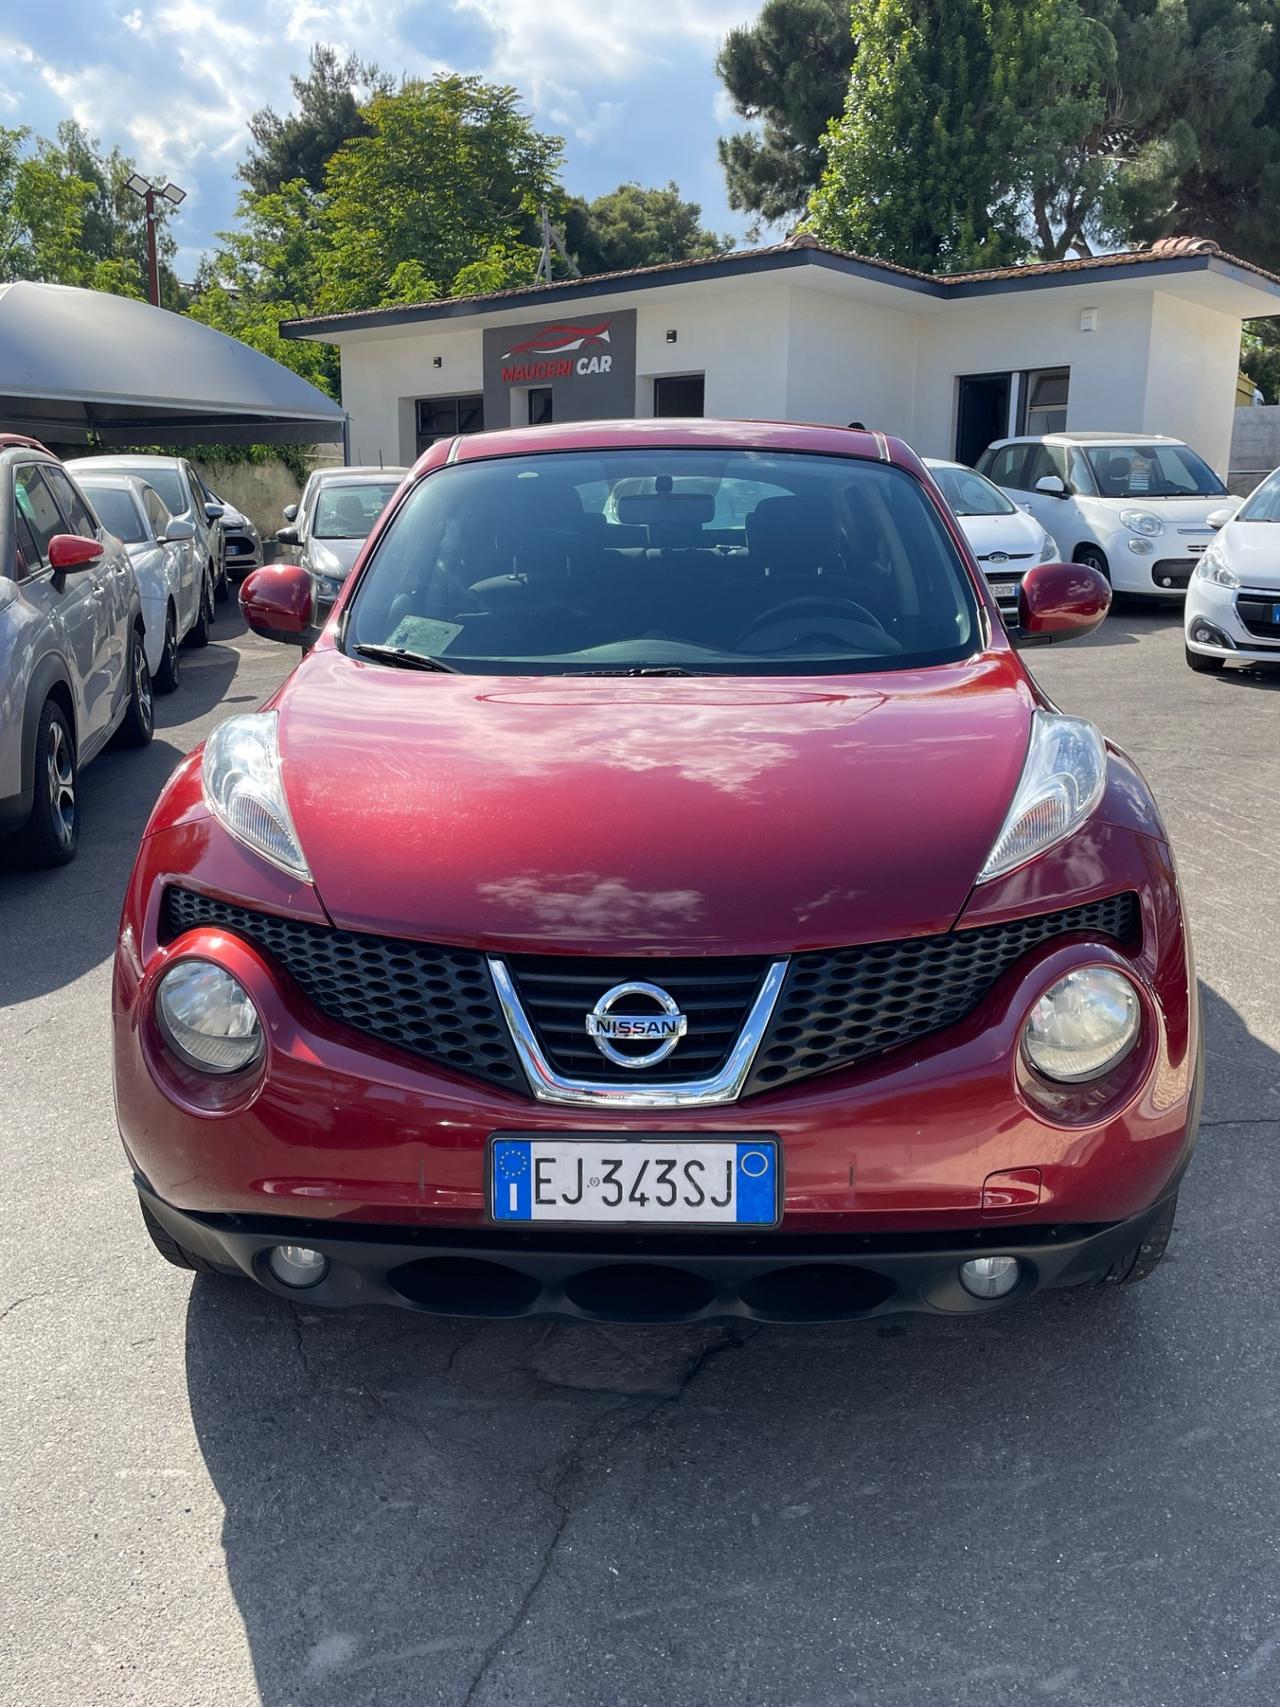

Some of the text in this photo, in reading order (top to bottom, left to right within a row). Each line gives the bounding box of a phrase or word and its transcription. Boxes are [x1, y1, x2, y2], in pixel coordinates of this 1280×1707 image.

[502, 355, 612, 382] MAUGERI CAR
[596, 1020, 677, 1034] NISSAN
